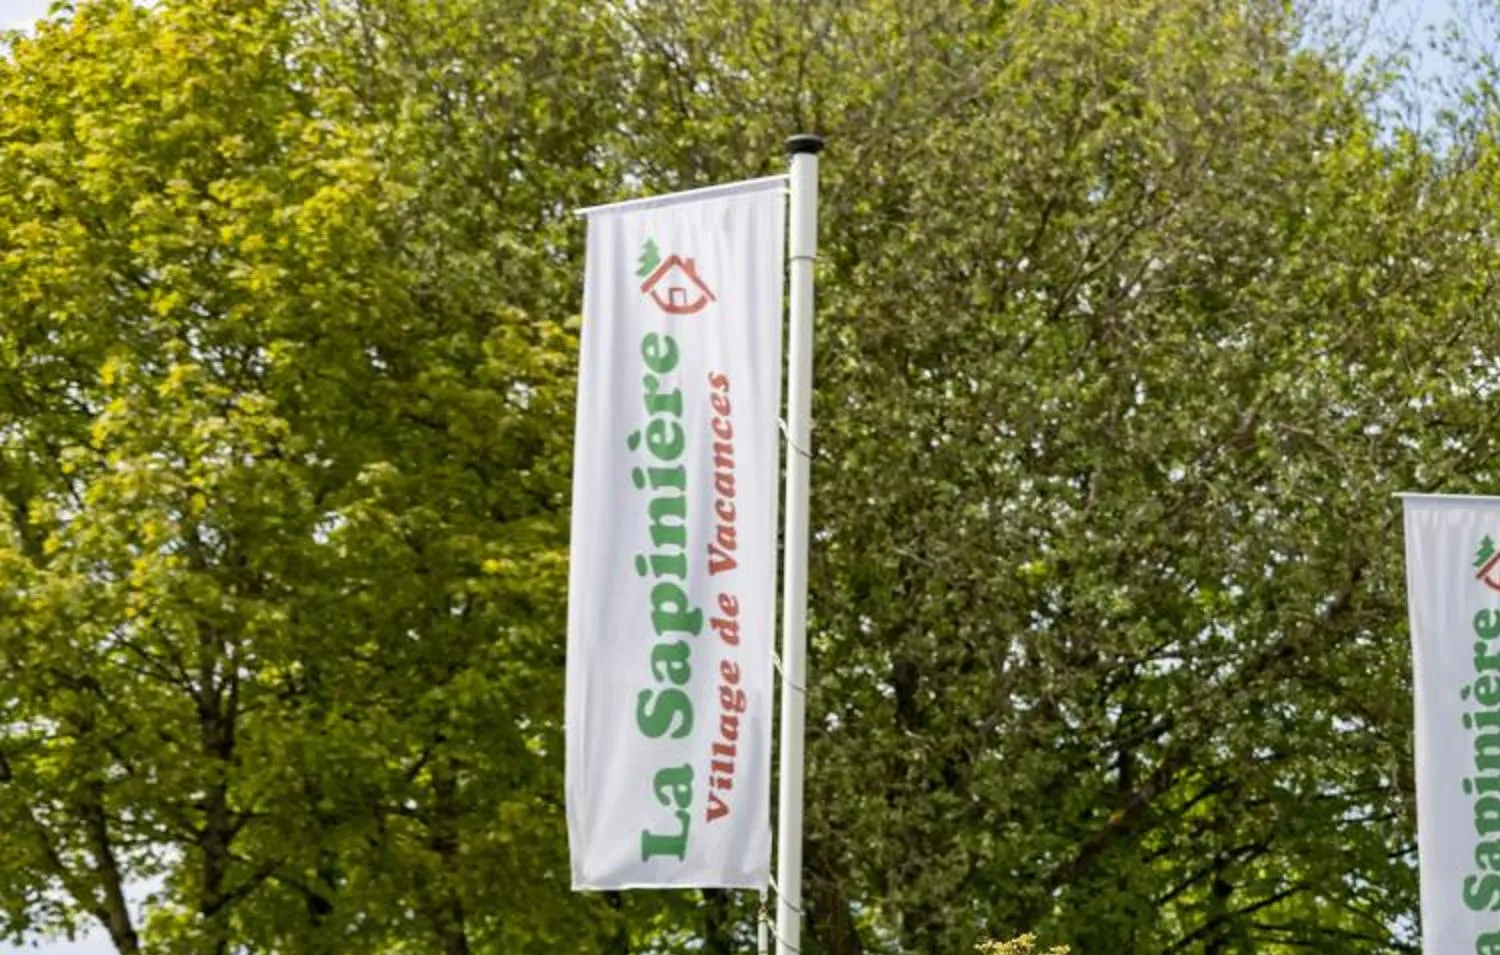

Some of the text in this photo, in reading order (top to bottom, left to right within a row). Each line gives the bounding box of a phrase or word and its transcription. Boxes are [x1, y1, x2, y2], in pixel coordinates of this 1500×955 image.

[627, 332, 705, 862] La Sapinière
[704, 371, 746, 824] Village de Vacances
